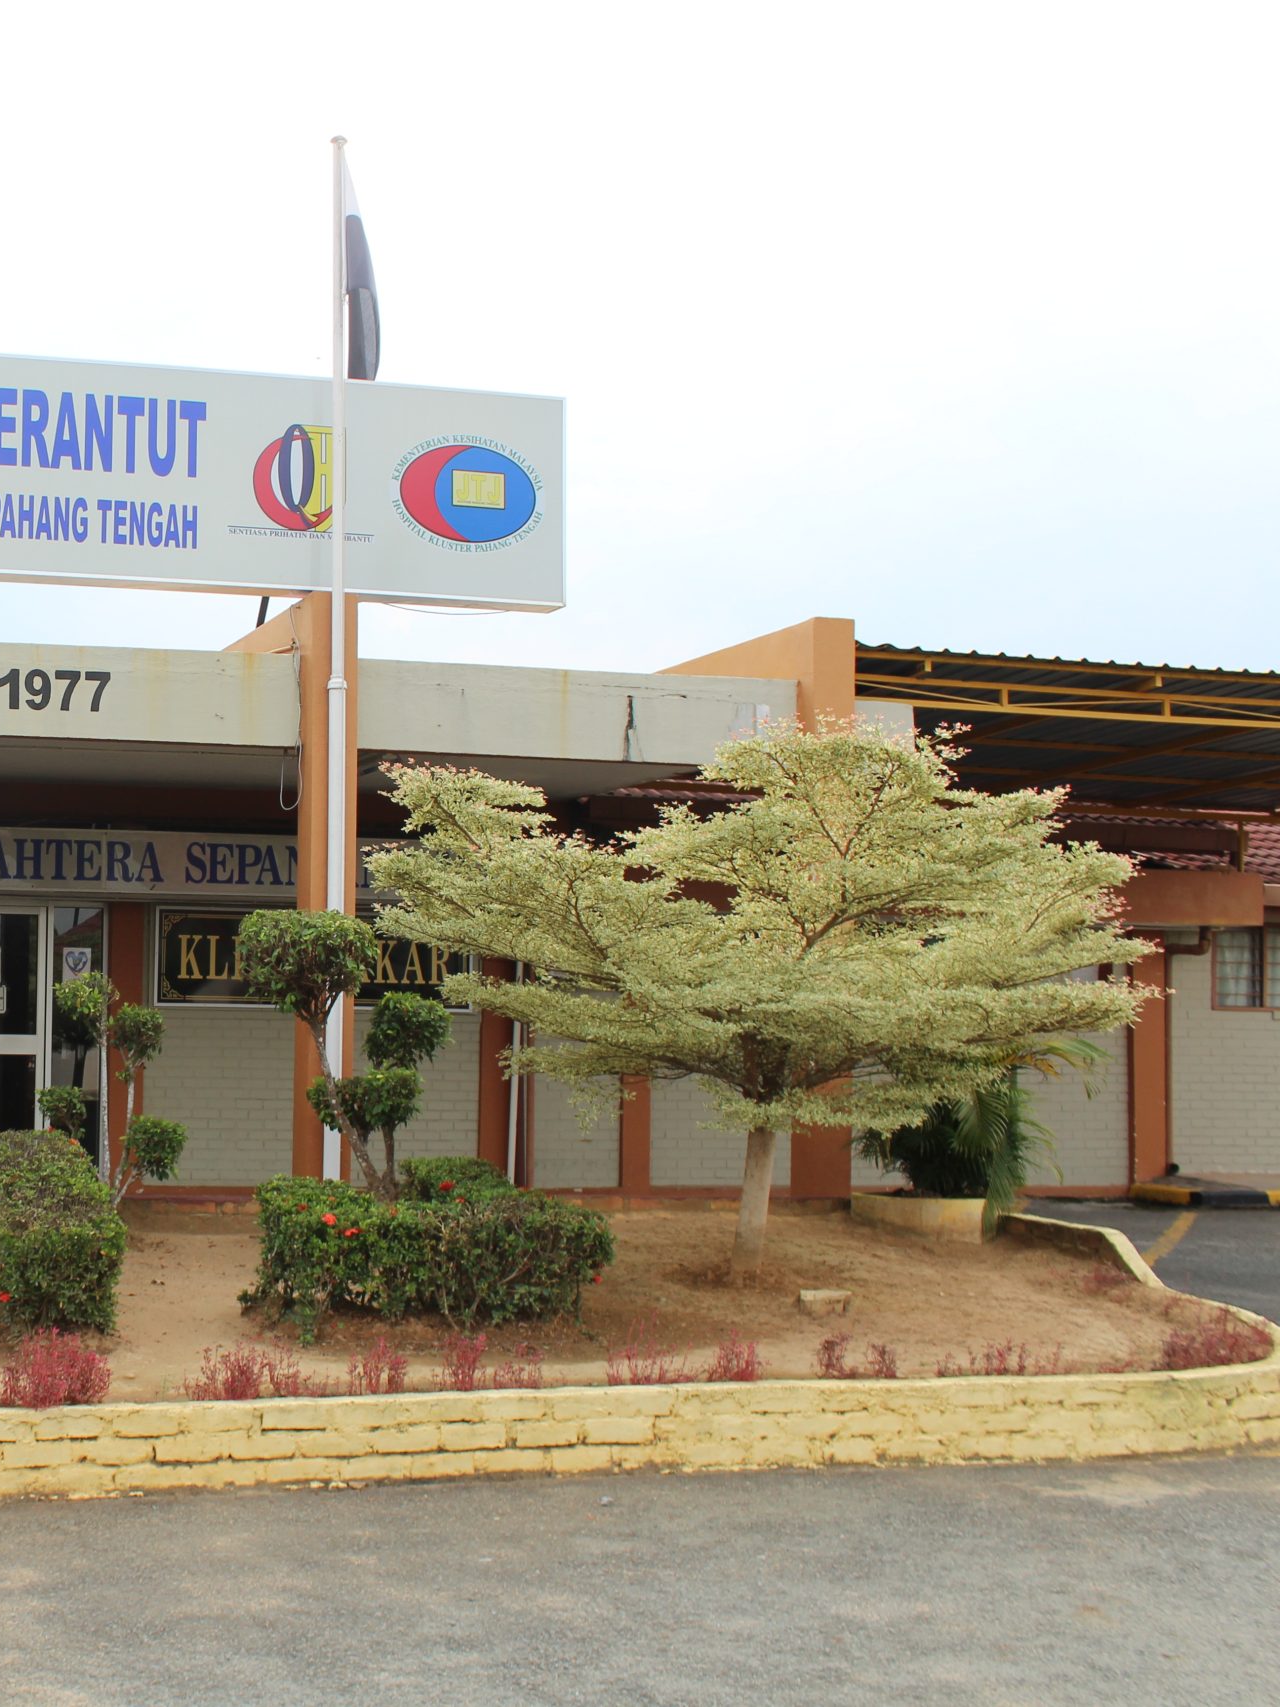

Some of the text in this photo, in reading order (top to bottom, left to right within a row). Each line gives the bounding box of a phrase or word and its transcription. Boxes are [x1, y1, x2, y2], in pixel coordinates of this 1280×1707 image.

[392, 434, 543, 491] KEMENTERIAN KESIHATAN MALAYSIA
[456, 472, 501, 504] JTJ
[97, 499, 198, 549] TENGAH
[228, 527, 268, 537] SENTIASA
[270, 530, 307, 539] PRIHATIN
[392, 499, 543, 553] HOSPITAL KLUSTER PAHANG TENGAH
